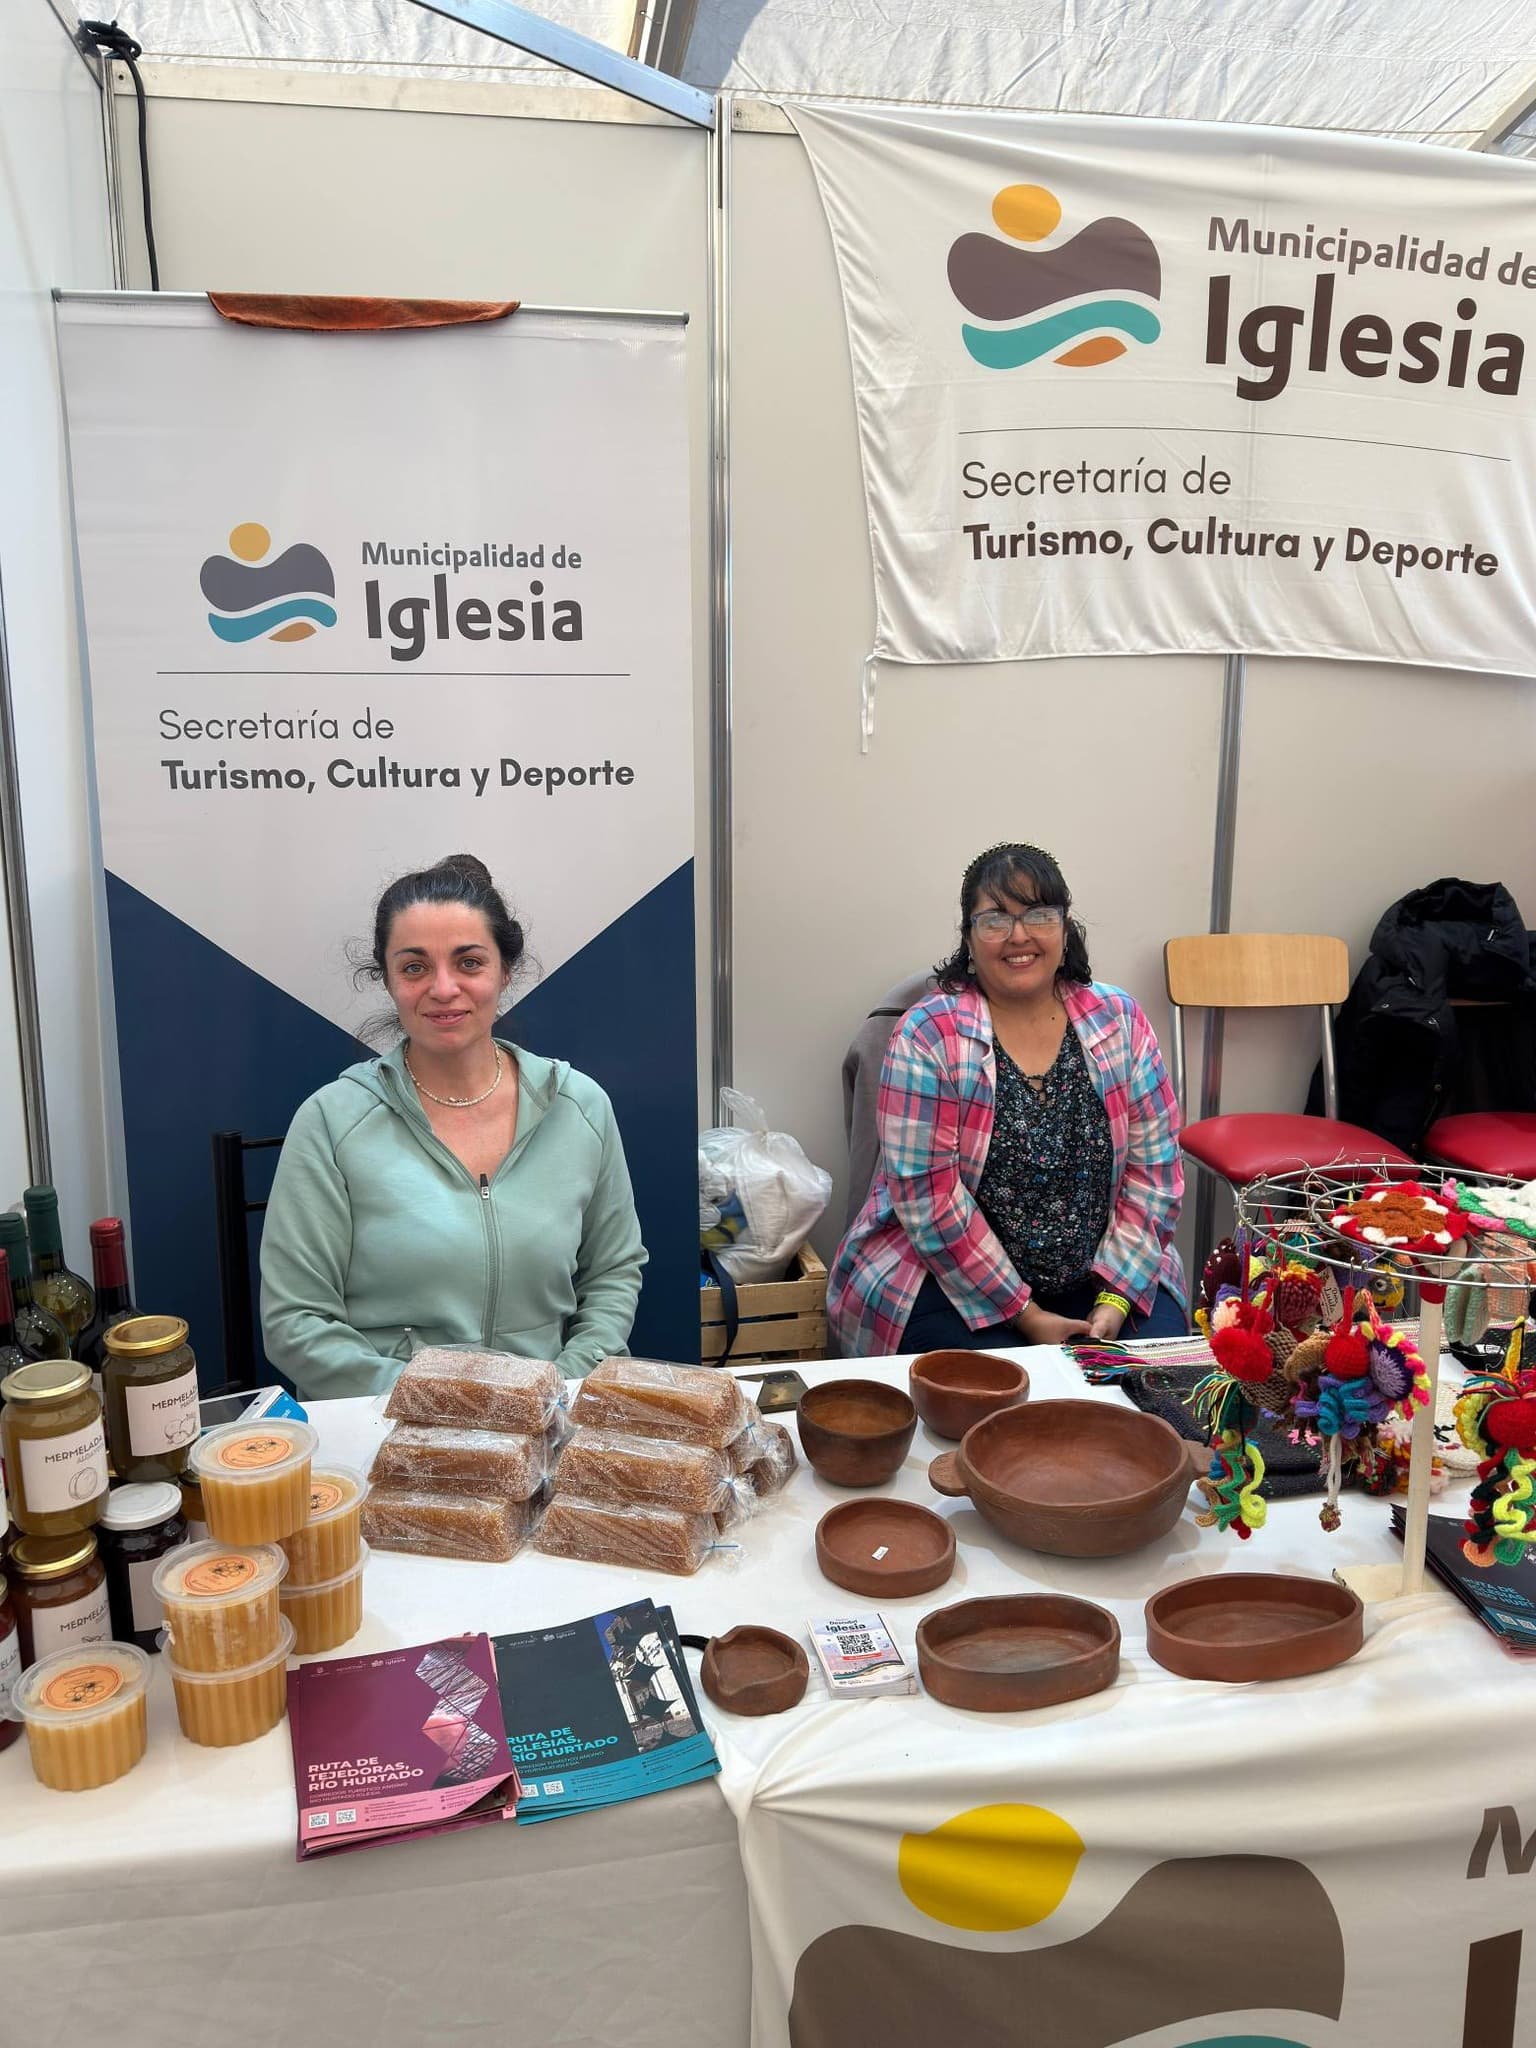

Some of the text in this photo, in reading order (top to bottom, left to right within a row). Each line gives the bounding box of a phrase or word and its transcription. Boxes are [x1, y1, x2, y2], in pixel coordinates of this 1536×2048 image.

[1207, 216, 1536, 290] Municipalidad de
[1205, 272, 1525, 402] Iglesia
[962, 454, 1232, 500] Secretaría de
[361, 541, 582, 574] Municipalidad de
[962, 515, 1499, 579] Turismo, Cultura y Deporte
[364, 573, 583, 662] Iglesia
[158, 706, 395, 741] Secretaría de
[160, 755, 635, 798] Turismo, Cultura y Deporte
[825, 1623, 867, 1633] Iglesia
[506, 1727, 573, 1745] RUTA DE
[510, 1735, 581, 1753] GLESIAS,
[541, 1736, 618, 1758] HURTADO
[308, 1756, 379, 1774] RUTA DE
[308, 1761, 410, 1782] TEJEDORAS,
[308, 1768, 424, 1793] RÍO HURTADO
